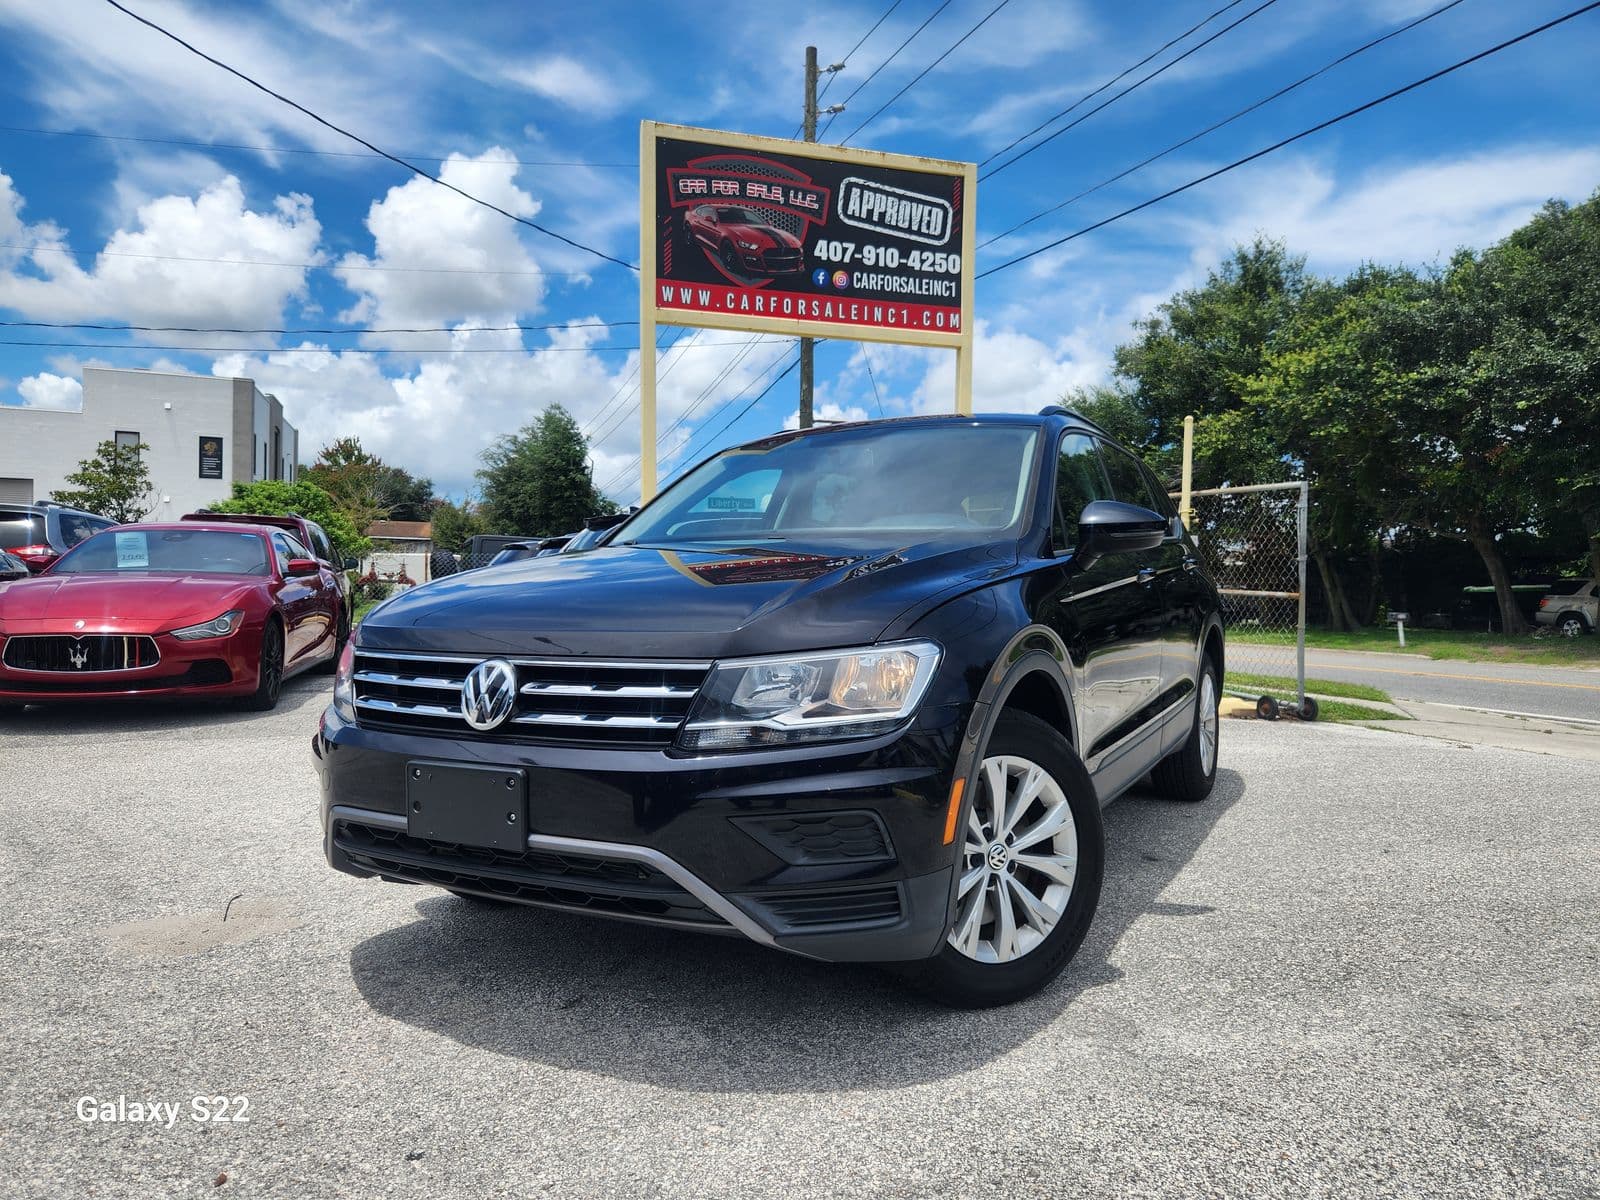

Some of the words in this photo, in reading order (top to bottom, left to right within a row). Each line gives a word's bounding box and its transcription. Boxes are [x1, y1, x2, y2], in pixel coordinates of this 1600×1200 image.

[679, 178, 707, 194] CAR
[711, 179, 740, 195] FOR
[746, 182, 785, 204] SALE,
[847, 187, 944, 236] APPROVED
[813, 239, 961, 274] 407-910-4250
[853, 271, 956, 297] CARFORSALEINC1
[661, 285, 961, 329] WWW.CARFORSALEINC1.COM
